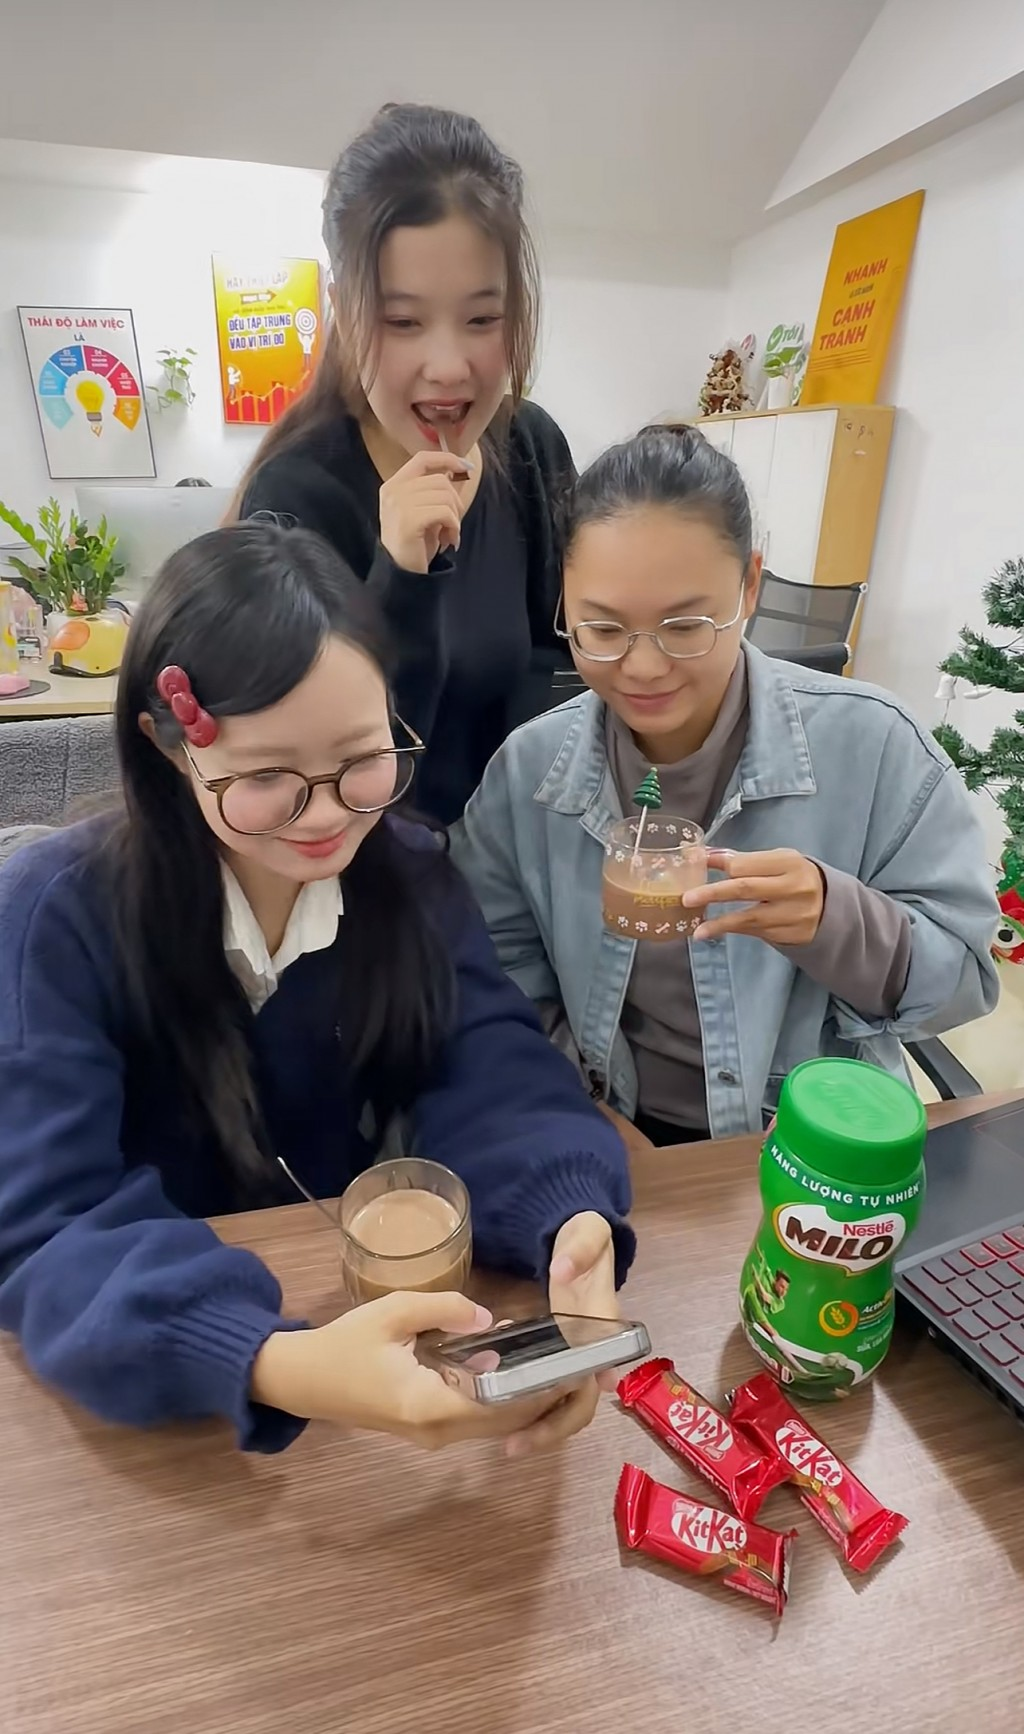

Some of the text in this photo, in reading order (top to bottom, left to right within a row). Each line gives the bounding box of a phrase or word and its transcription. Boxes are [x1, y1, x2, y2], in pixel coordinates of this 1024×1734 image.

[843, 258, 888, 286] NHANH
[27, 315, 125, 331] THÁI ĐỘ LÀM VIỆC
[264, 314, 291, 328] TRUNG
[801, 1175, 853, 1204] LƯỢNG
[860, 1194, 881, 1208] TỰ
[785, 1215, 894, 1261] MILO
[843, 1220, 894, 1237] Nestlé
[669, 1403, 731, 1448] KitKat
[777, 1431, 842, 1483] KitKat
[678, 1507, 744, 1552] KitKat
